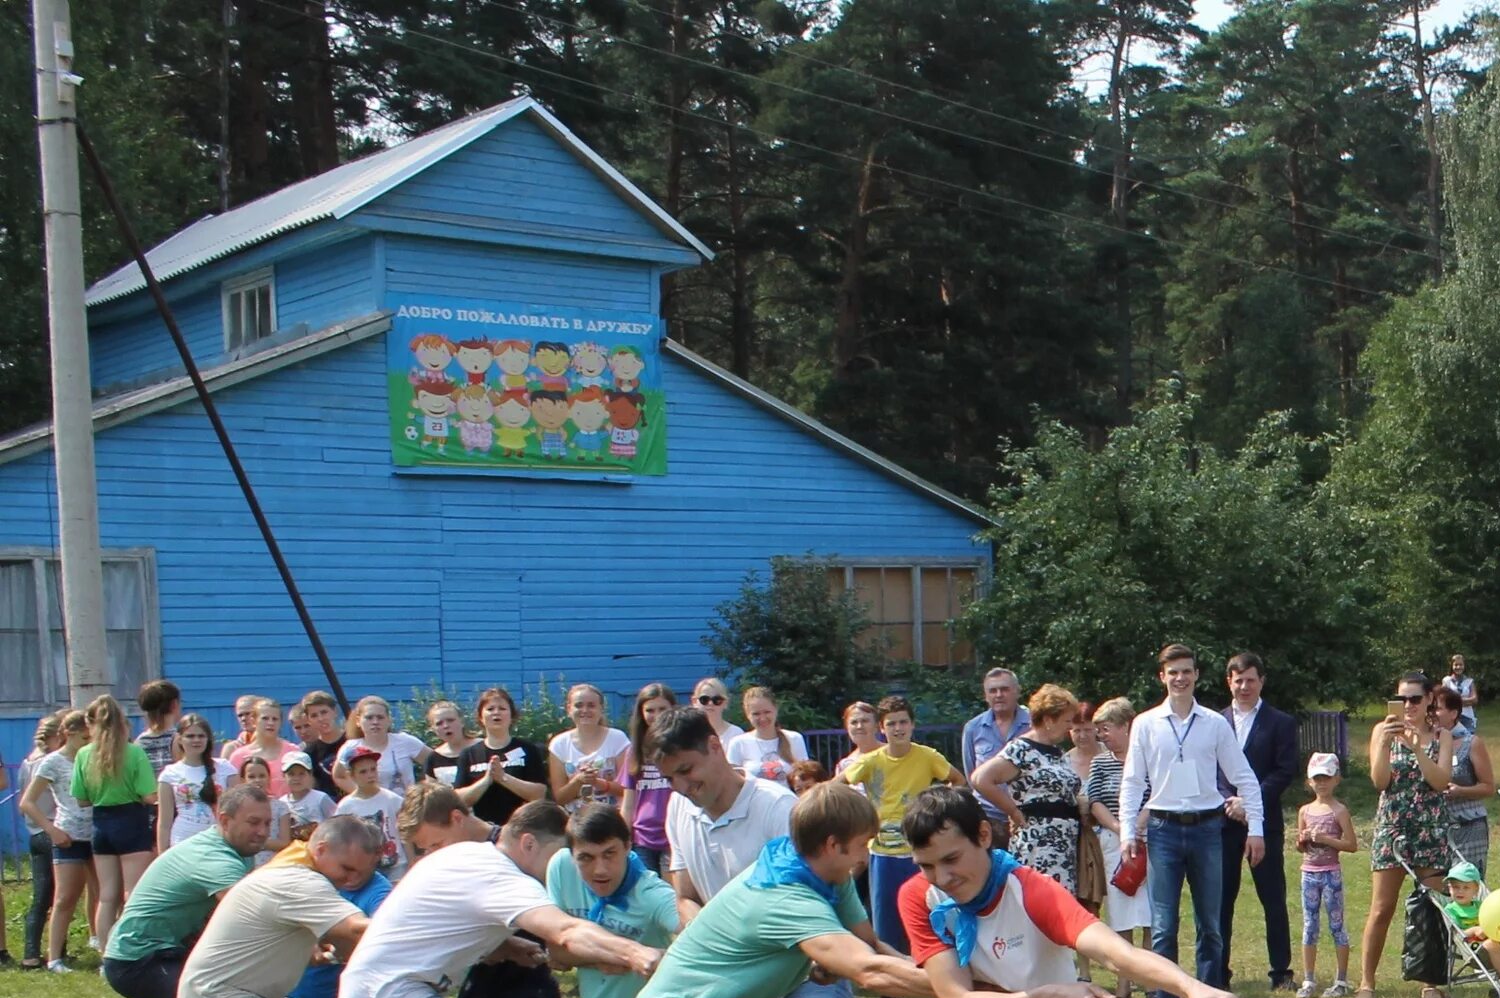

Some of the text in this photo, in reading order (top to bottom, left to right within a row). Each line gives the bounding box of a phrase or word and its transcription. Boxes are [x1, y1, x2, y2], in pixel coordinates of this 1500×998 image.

[397, 304, 652, 335] ДОБРО ПОЖАЛОВАТЬ В ДРУЖБУ
